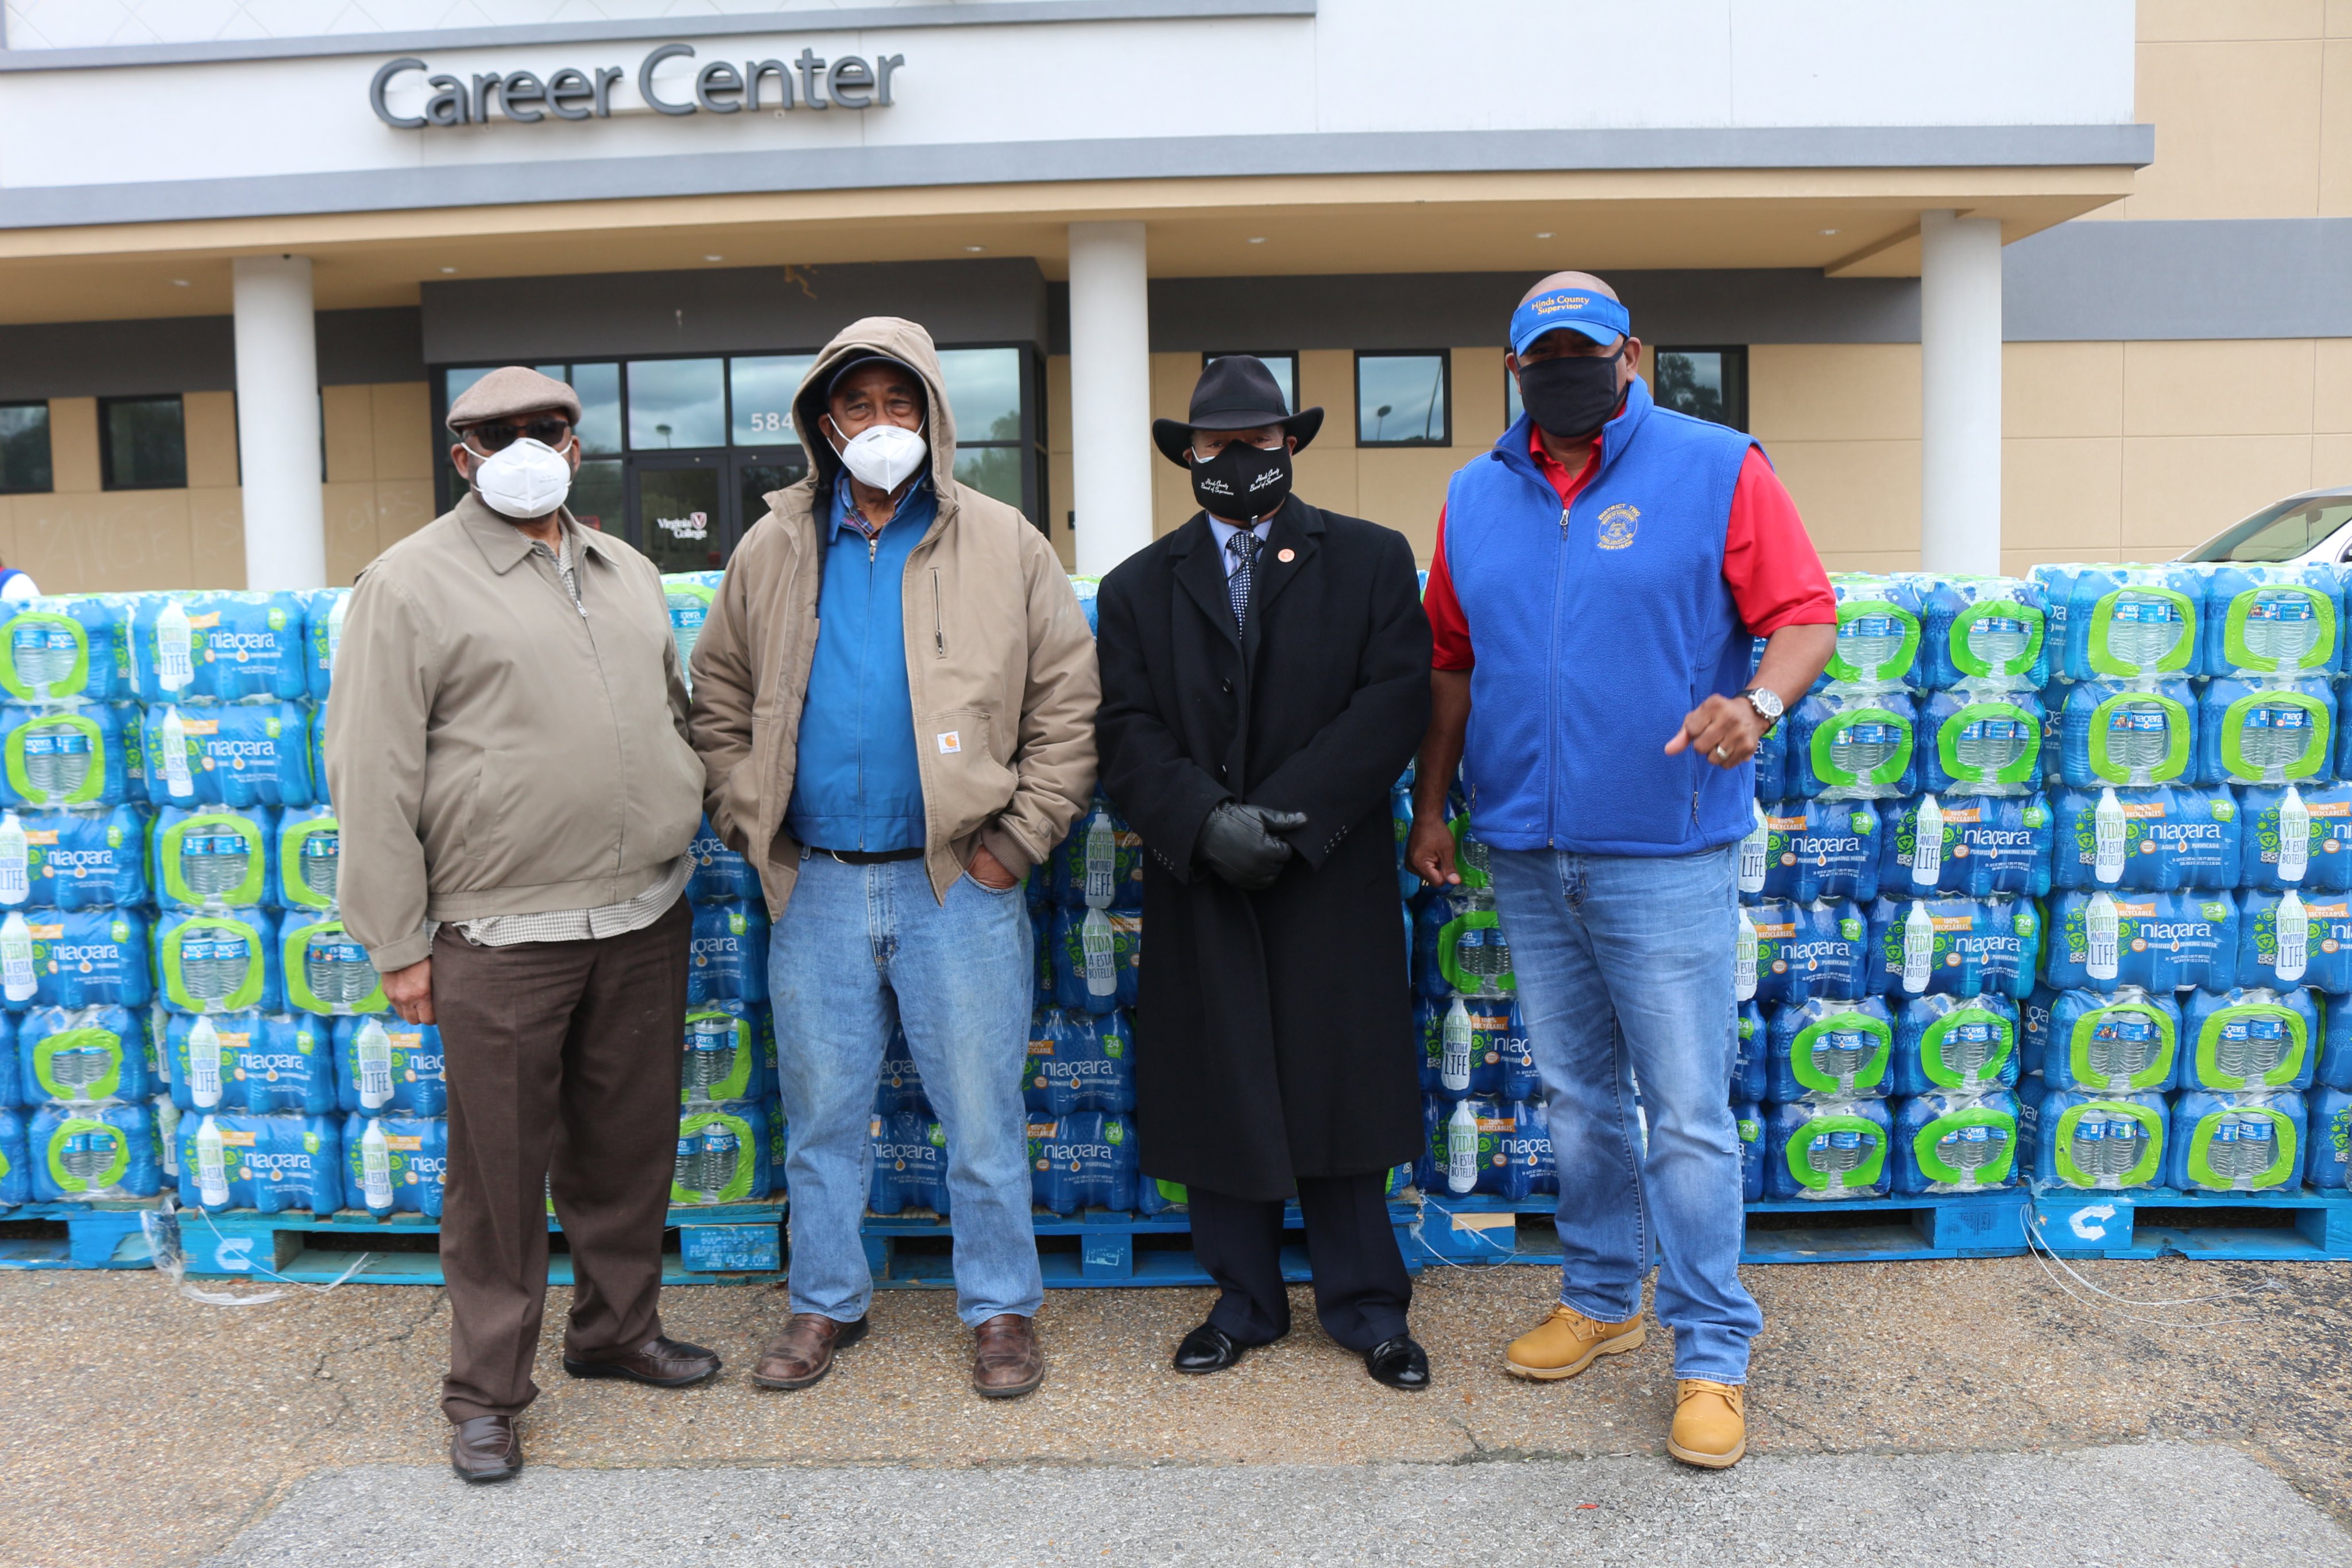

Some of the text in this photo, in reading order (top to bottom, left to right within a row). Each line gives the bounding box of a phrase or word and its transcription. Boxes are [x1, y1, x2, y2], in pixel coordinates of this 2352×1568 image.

[370, 42, 904, 129] Career Center
[1531, 295, 1590, 311] Hinds County
[1537, 303, 1583, 315] Supervisor
[1268, 468, 1280, 478] County
[1201, 482, 1211, 490] Board
[1216, 480, 1229, 490] County
[1250, 483, 1262, 492] Board
[1598, 503, 1626, 520] DISTRICT
[1628, 505, 1641, 517] TWO
[656, 518, 693, 531] Virginia
[674, 528, 707, 540] College
[1597, 540, 1634, 549] SUPERVISOR
[210, 631, 275, 656] niagara
[2133, 714, 2162, 725] niagara
[207, 738, 275, 763] niagara
[2026, 810, 2040, 819] 24
[2215, 803, 2230, 812] 24
[1855, 816, 1869, 825] 24
[2098, 822, 2123, 839] VIDA
[2150, 822, 2221, 846] niagara
[2283, 821, 2306, 838] VIDA
[1964, 828, 2030, 853] niagara
[2100, 841, 2122, 853] A ESTA
[2284, 840, 2305, 853] A ESTA
[1089, 843, 1113, 860] BOTTLE
[1743, 843, 1765, 854] ANOTHER
[1791, 836, 1860, 860] niagara
[48, 849, 113, 872] niagara
[1917, 847, 1940, 870] LIFE
[2098, 854, 2122, 866] BOTELLA
[2282, 854, 2305, 865] BOTELLA
[1089, 861, 1112, 872] ANOTHER
[1742, 855, 1763, 877] LIFE
[1089, 873, 1112, 896] LIFE
[2206, 904, 2222, 913] 24
[1844, 922, 1858, 931] 24
[2018, 918, 2032, 927] 24
[2090, 917, 2117, 931] BOTTLE
[2280, 919, 2305, 934] BOTTLE
[2091, 932, 2115, 943] ANOTHER
[2141, 922, 2211, 946] niagara
[2281, 934, 2304, 945] ANOTHER
[1085, 935, 1112, 953] VIDA
[1907, 936, 1931, 953] VIDA
[1956, 936, 2021, 959] niagara
[53, 944, 119, 966] niagara
[1089, 954, 1112, 967] A ESTA
[1781, 942, 1851, 965] niagara
[1908, 954, 1929, 966] A ESTA
[2091, 944, 2114, 966] LIFE
[2281, 945, 2304, 967] LIFE
[1088, 967, 1115, 979] BOTELLA
[1740, 962, 1755, 974] ESTA
[1906, 967, 1930, 978] BOTELLA
[1445, 1026, 1469, 1042] BOTTLE
[1107, 1039, 1120, 1049] 24
[1445, 1043, 1468, 1054] ANOTHER
[240, 1052, 304, 1075] niagara
[1445, 1055, 1467, 1077] LIFE
[1042, 1059, 1113, 1083] niagara
[195, 1071, 218, 1093] LIFE
[364, 1072, 389, 1094] LIFE
[1108, 1126, 1120, 1136] 24
[1742, 1124, 1755, 1133] 24
[1450, 1135, 1476, 1152] VIDA
[872, 1142, 937, 1166] niagara
[1043, 1143, 1112, 1166] niagara
[1452, 1153, 1475, 1166] A ESTA
[245, 1152, 311, 1175] niagara
[1451, 1166, 1476, 1178] BOTELLA
